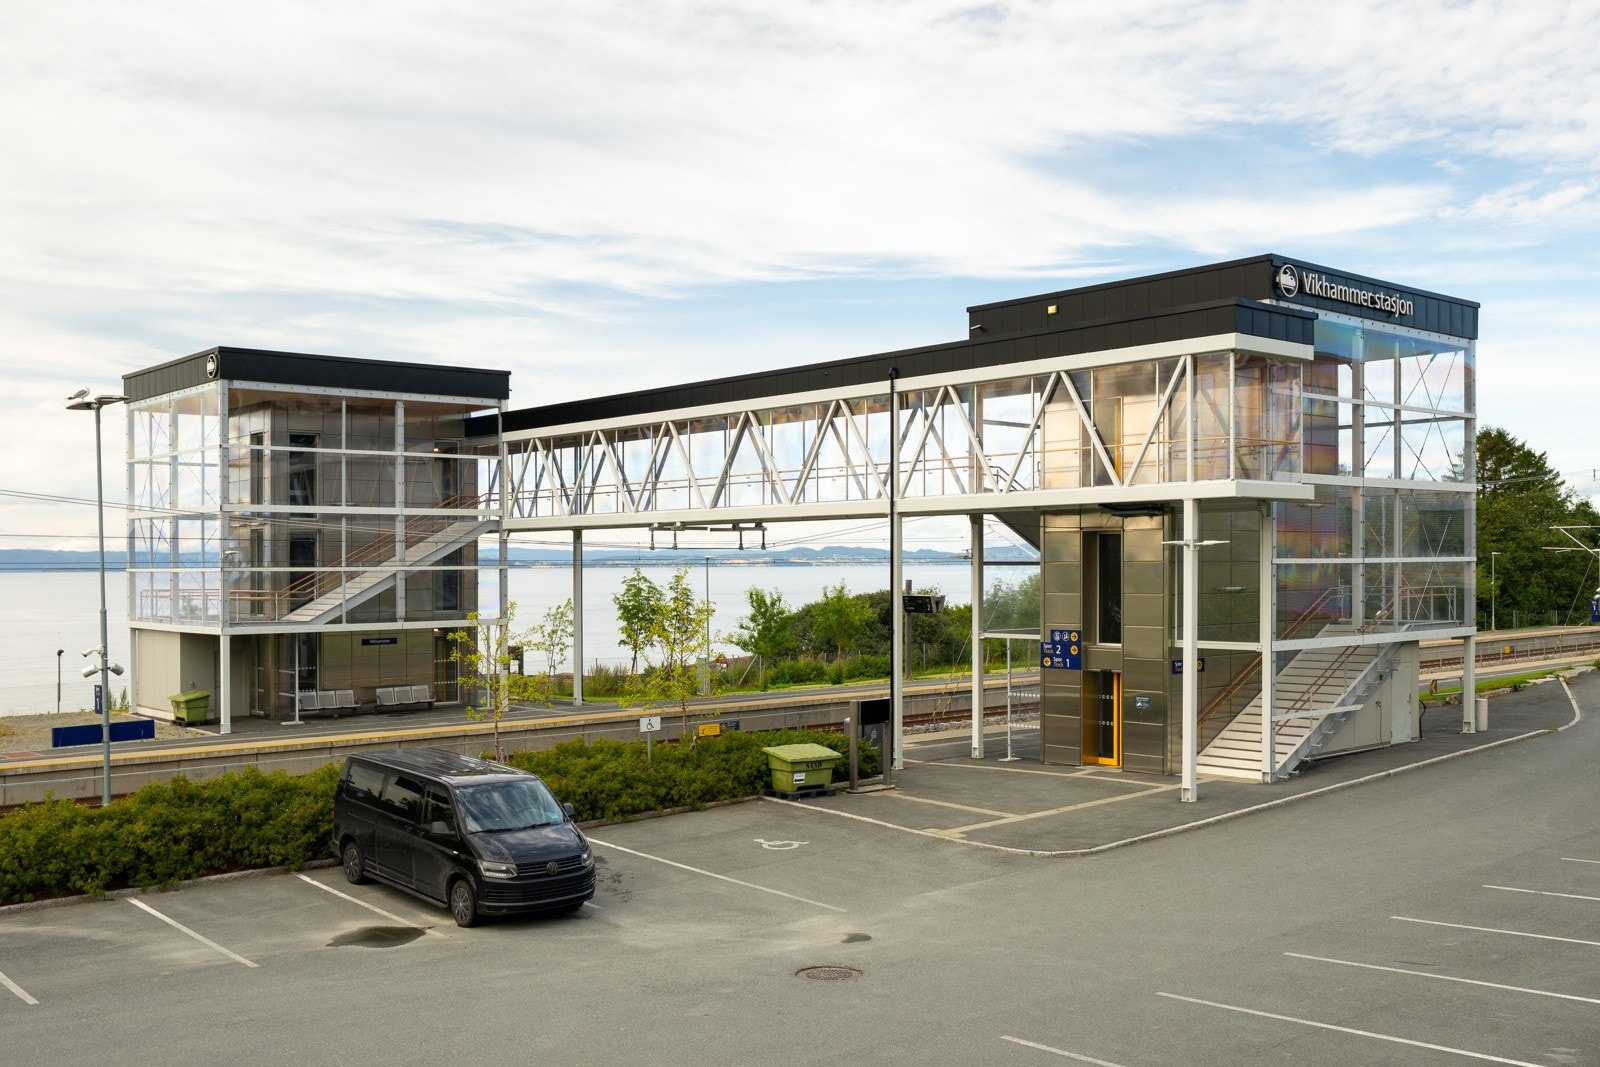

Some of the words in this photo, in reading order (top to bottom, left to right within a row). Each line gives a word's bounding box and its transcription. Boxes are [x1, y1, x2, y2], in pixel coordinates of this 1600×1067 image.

[1302, 271, 1373, 307] Vikhammer
[1374, 292, 1413, 318] stasjon
[1055, 644, 1061, 654] 2
[1053, 656, 1063, 664] Spor
[1066, 658, 1070, 668] 1
